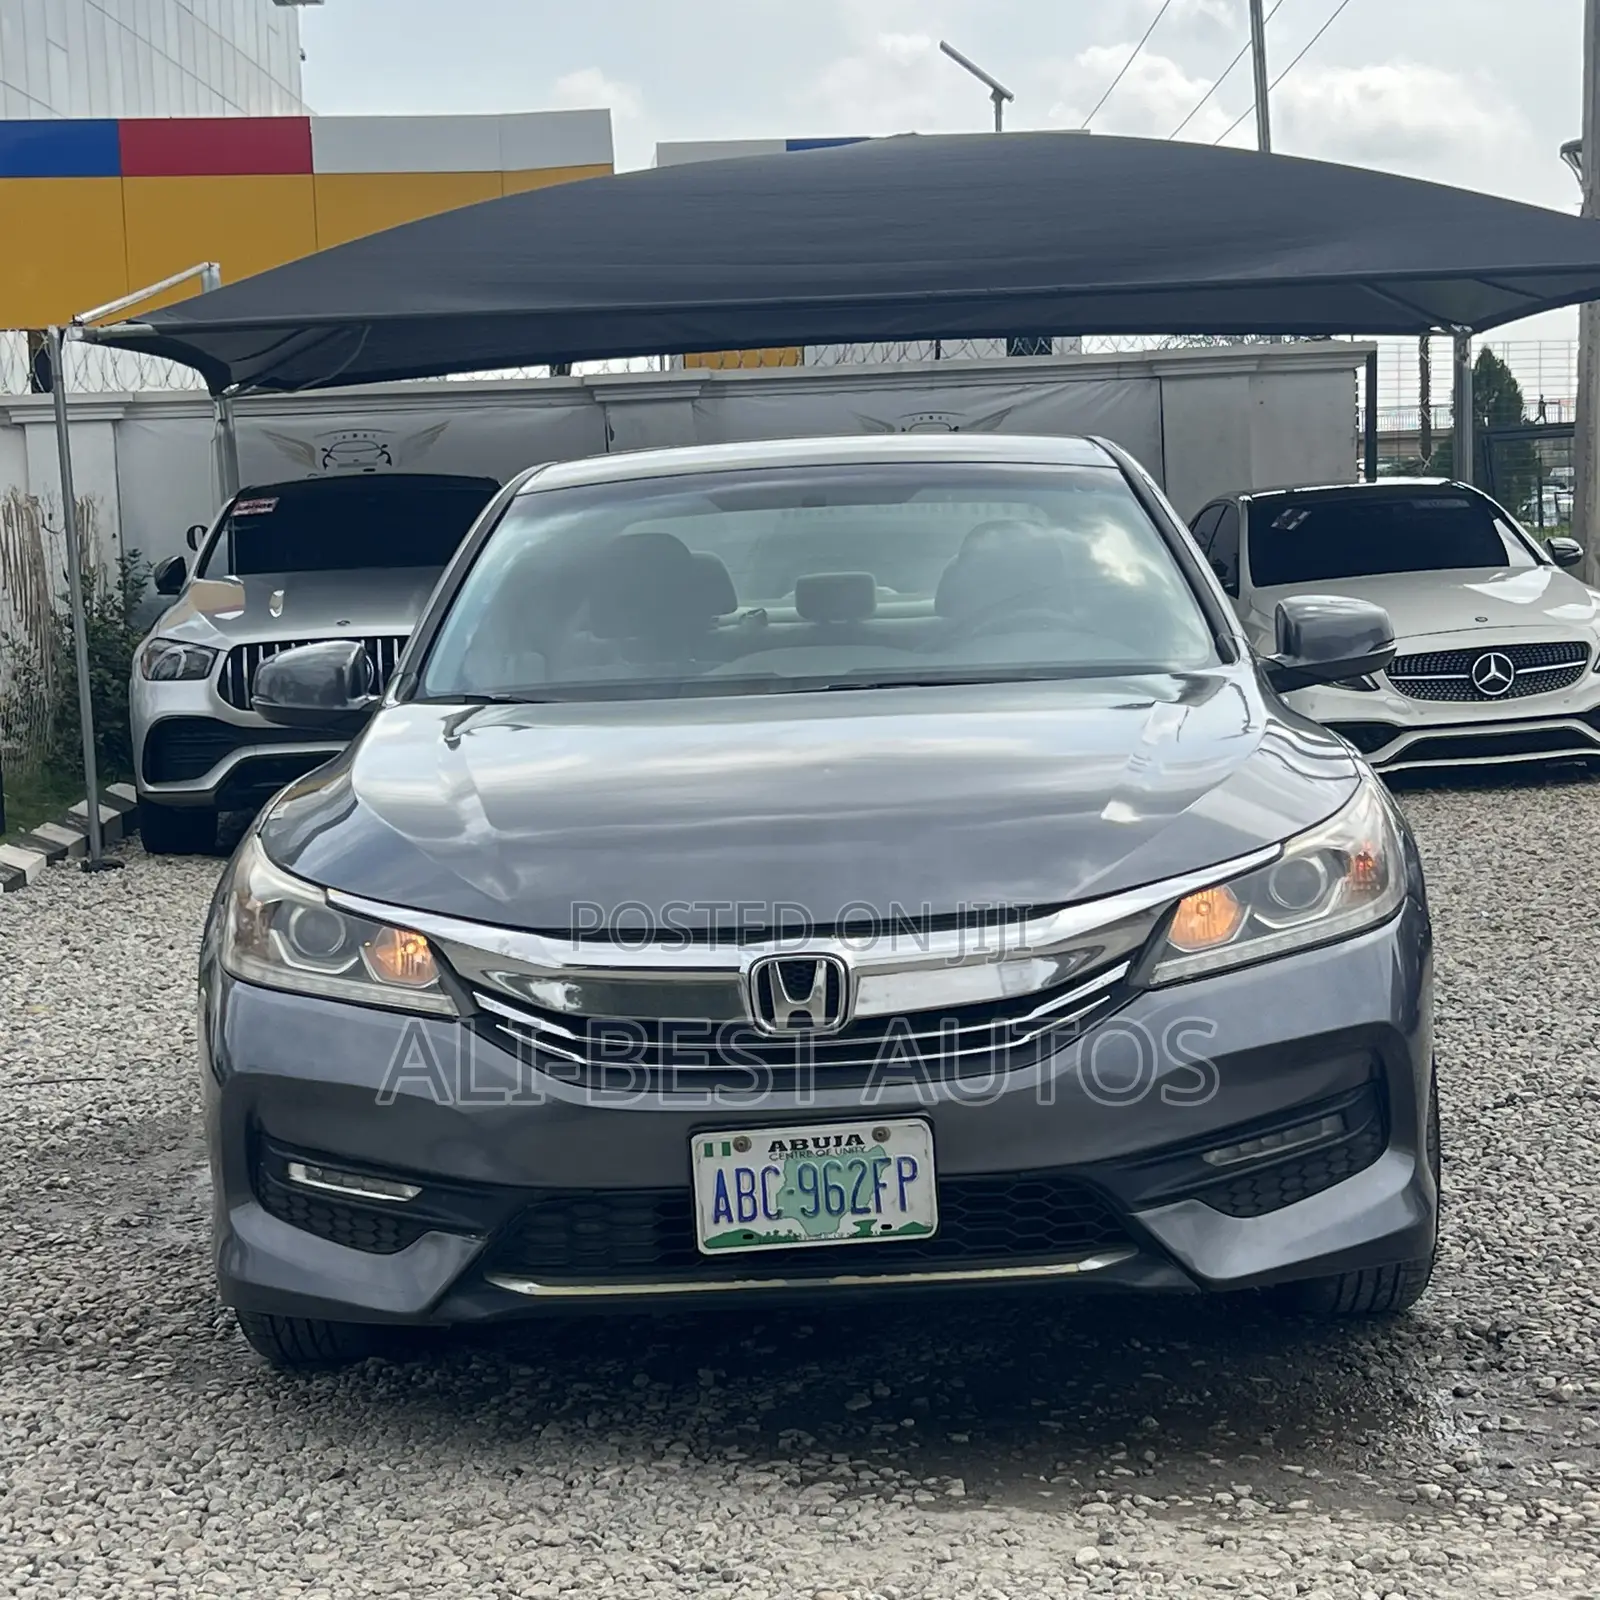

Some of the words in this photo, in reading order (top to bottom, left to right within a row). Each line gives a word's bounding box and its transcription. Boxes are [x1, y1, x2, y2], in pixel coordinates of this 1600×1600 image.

[768, 1133, 865, 1152] ABUJA
[768, 1150, 814, 1162] CENTRE
[815, 1148, 830, 1157] OF
[835, 1145, 867, 1156] UNITY
